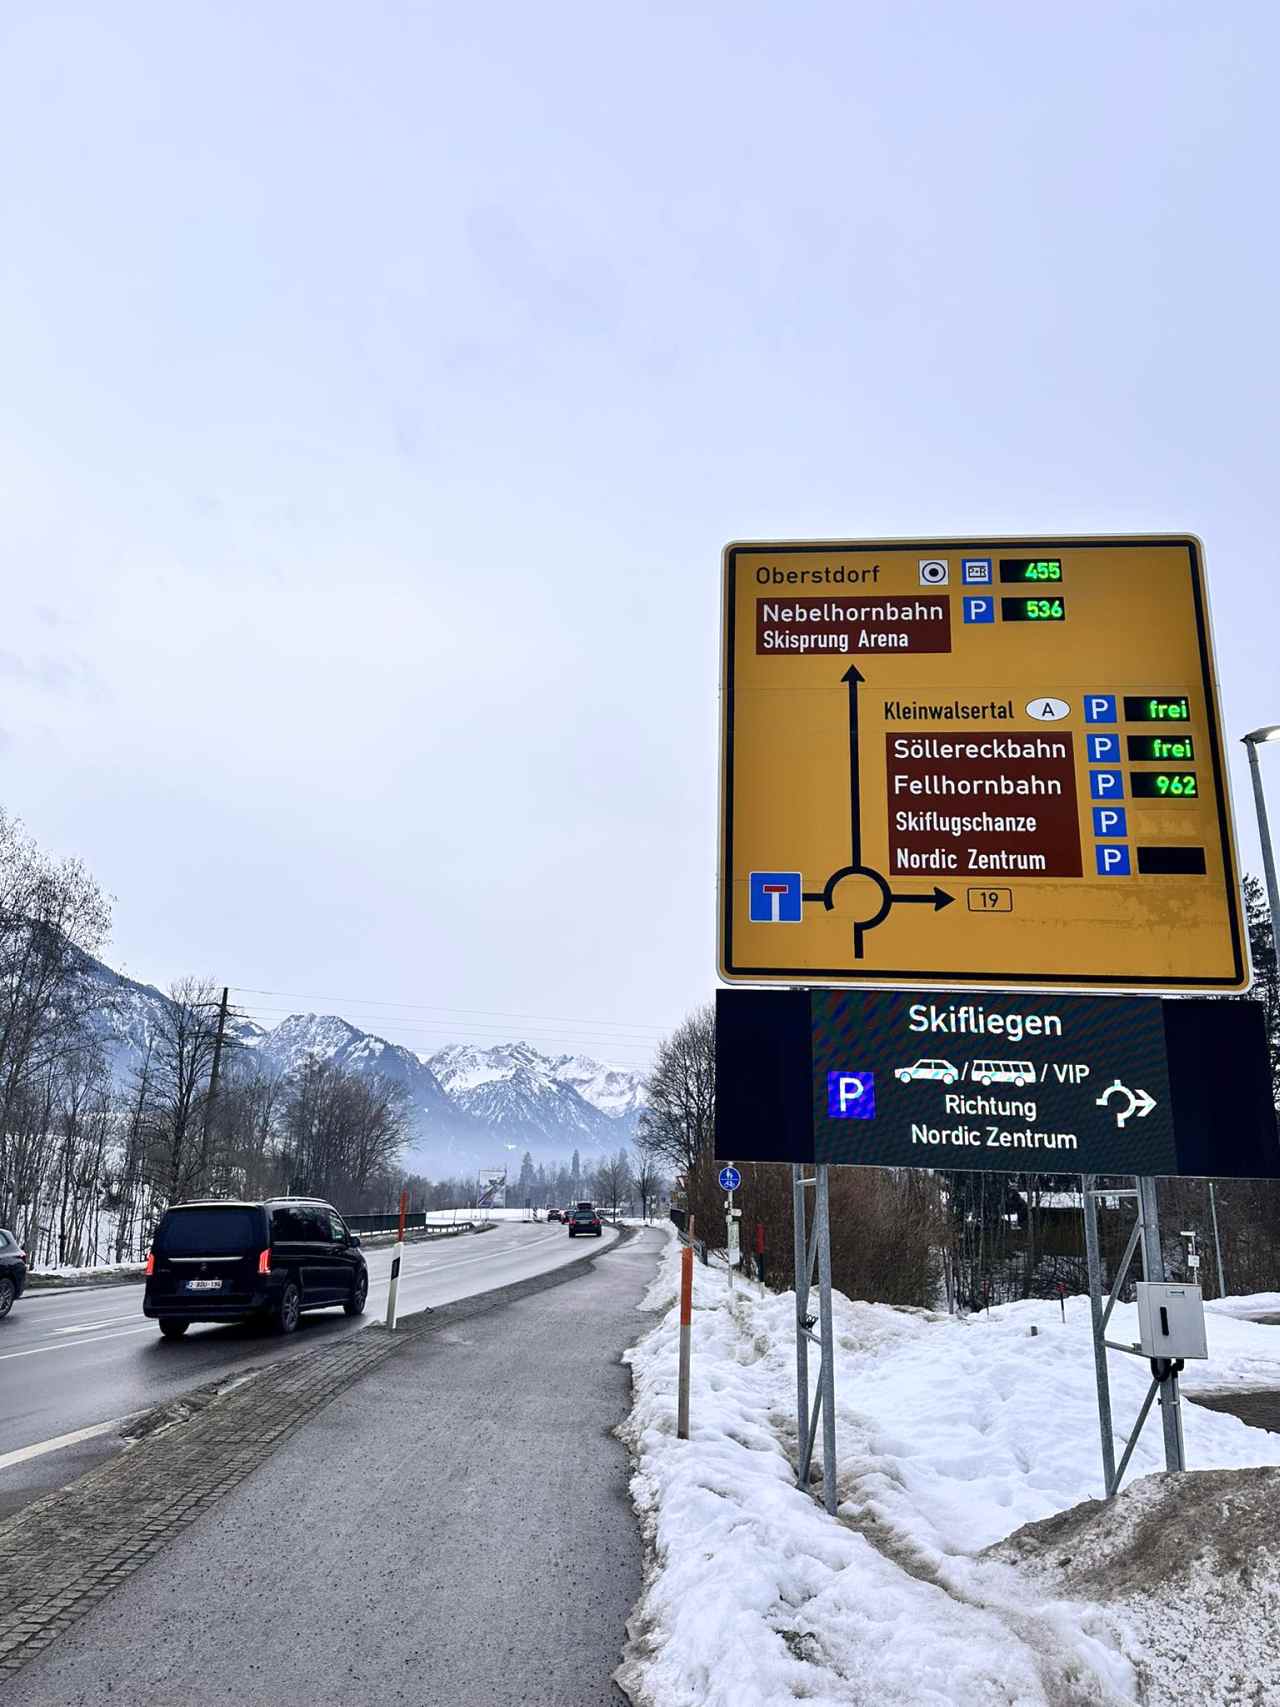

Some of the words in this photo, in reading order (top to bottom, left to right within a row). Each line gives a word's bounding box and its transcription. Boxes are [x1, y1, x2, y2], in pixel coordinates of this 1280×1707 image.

[757, 565, 880, 585] Oberstdorf
[1025, 562, 1060, 580] 455
[763, 603, 943, 622] Nebelhornbahn
[970, 600, 987, 620] P
[1026, 600, 1063, 619] 536
[763, 631, 849, 653] Skisprung
[858, 630, 909, 648] Arena
[885, 701, 1015, 720] Kleinwalsertal
[1041, 702, 1055, 717] A
[1091, 699, 1109, 720] P
[1150, 699, 1187, 719] frei
[894, 738, 1066, 759] Söllereckbahn
[1094, 738, 1112, 759] P
[1153, 738, 1192, 758] frei
[894, 775, 1062, 795] Fellhornbahn
[1097, 775, 1115, 796] P
[1157, 775, 1196, 795] 962
[896, 811, 1037, 836] Skiflugschanze
[1101, 811, 1118, 833] P
[896, 848, 958, 869] Nordic
[967, 848, 1046, 870] Zentrum
[1104, 849, 1122, 872] P
[980, 892, 999, 908] 19
[909, 1005, 1062, 1041] Skifliegen
[1052, 1063, 1090, 1084] VIP
[840, 1077, 864, 1112] P
[945, 1095, 1037, 1122] Richtung
[911, 1123, 981, 1146] Nordic
[985, 1126, 1078, 1149] Zentrum
